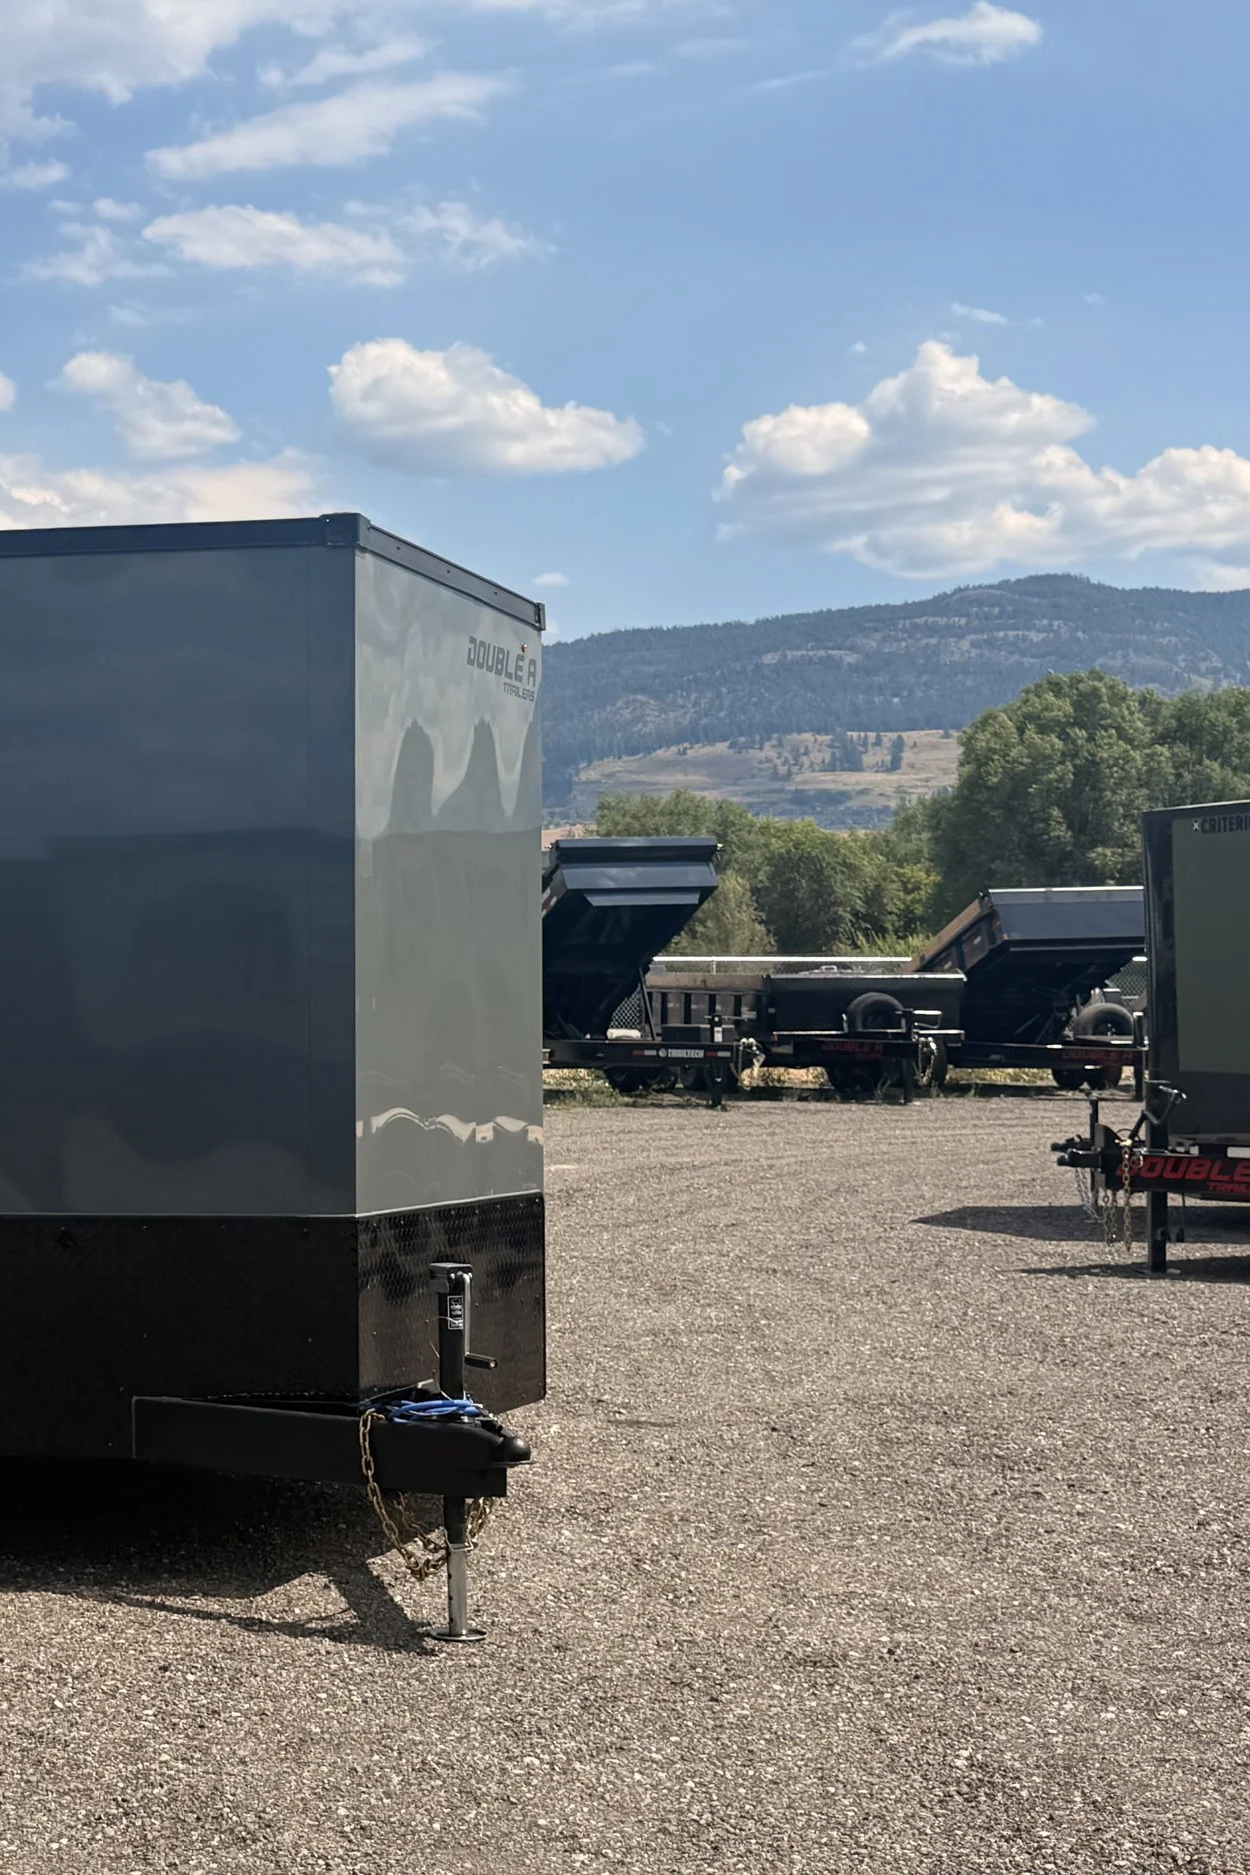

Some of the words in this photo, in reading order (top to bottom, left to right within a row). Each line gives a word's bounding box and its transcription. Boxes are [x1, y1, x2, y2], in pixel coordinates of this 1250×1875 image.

[466, 636, 525, 683] DOUBLE
[527, 658, 537, 687] A
[503, 682, 535, 702] TRAILERS
[1201, 814, 1250, 834] CRITERI
